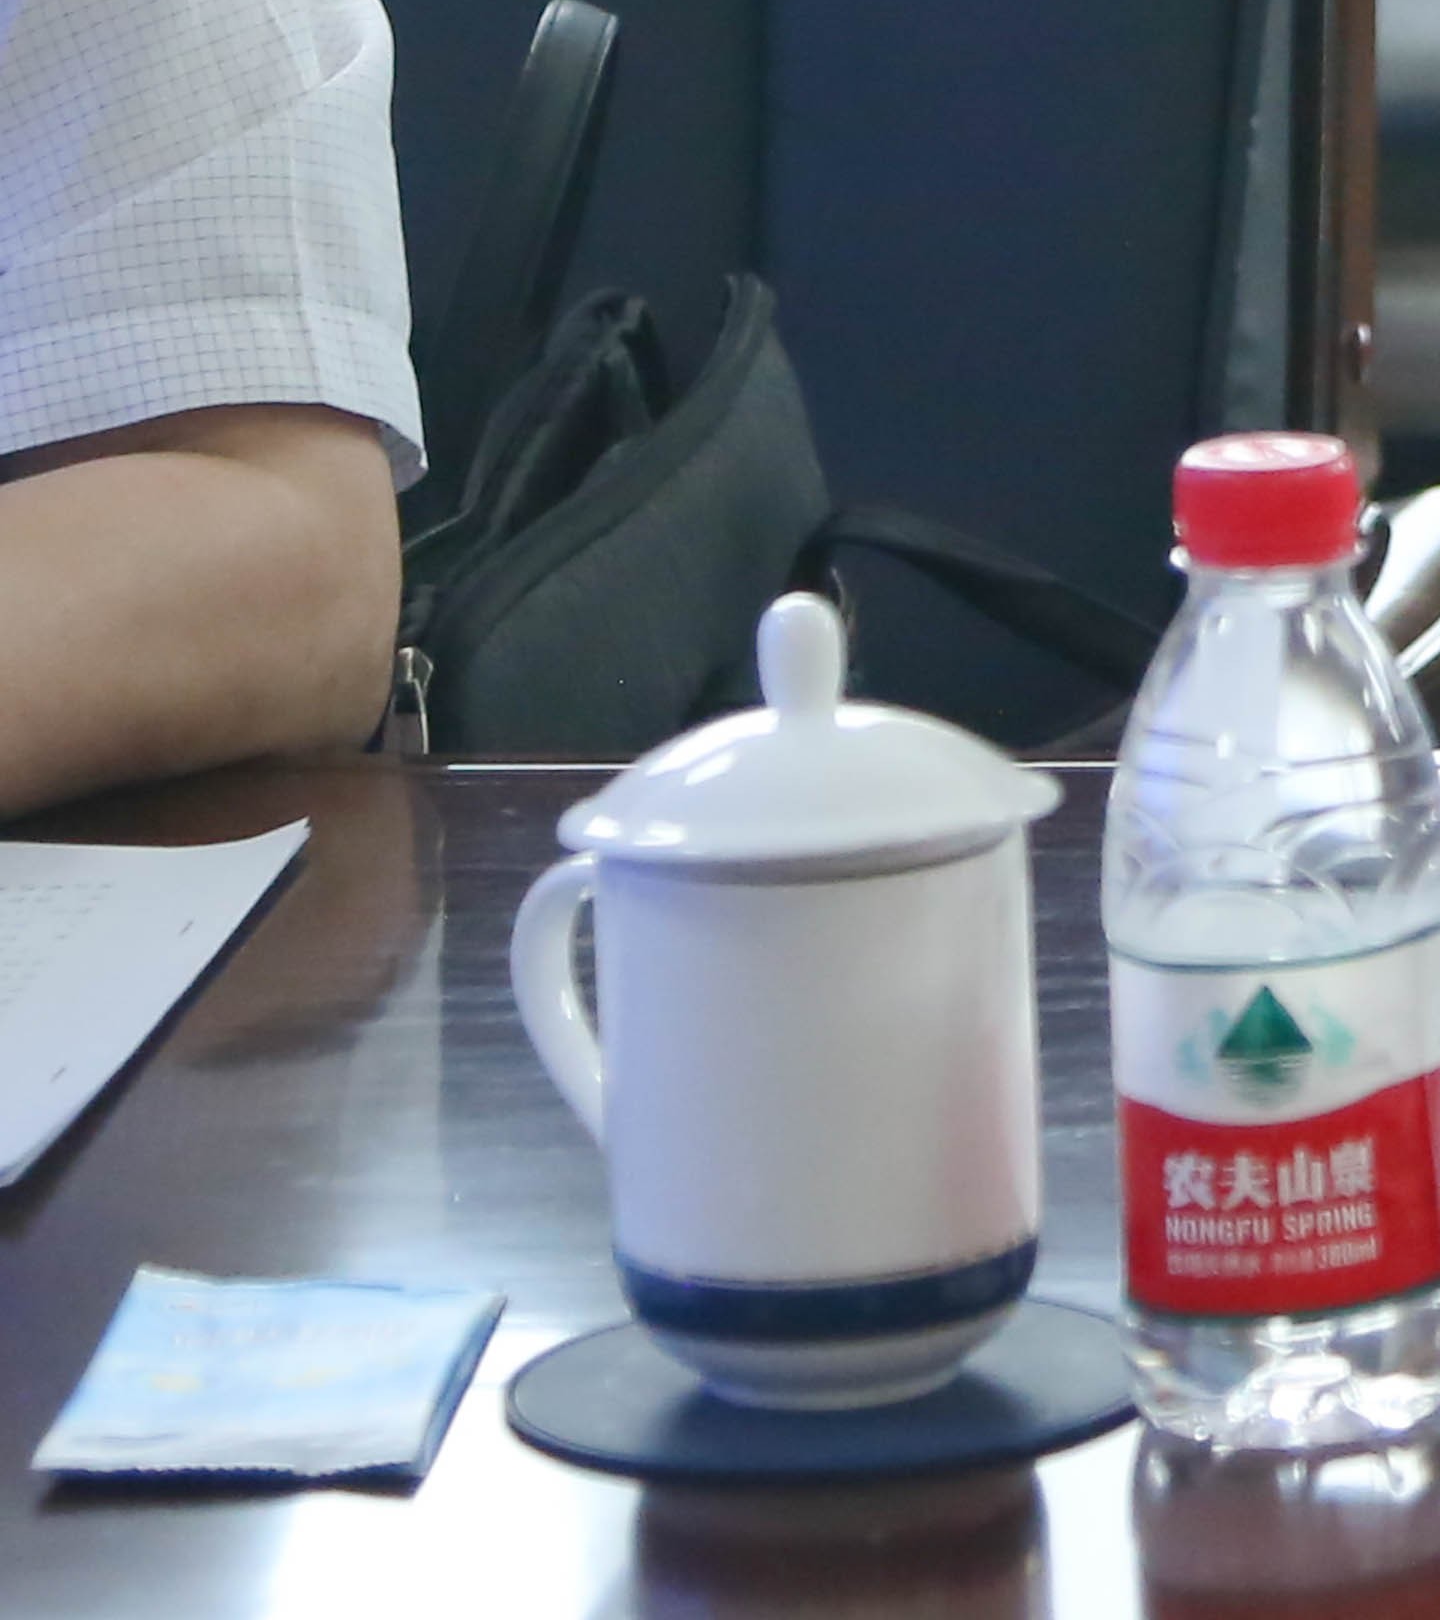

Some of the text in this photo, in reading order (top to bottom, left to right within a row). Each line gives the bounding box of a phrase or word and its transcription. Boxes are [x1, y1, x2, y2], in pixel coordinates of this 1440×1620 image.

[1164, 1136, 1375, 1210] 农夫山泉
[1165, 1201, 1376, 1244] NONGFU SPRING
